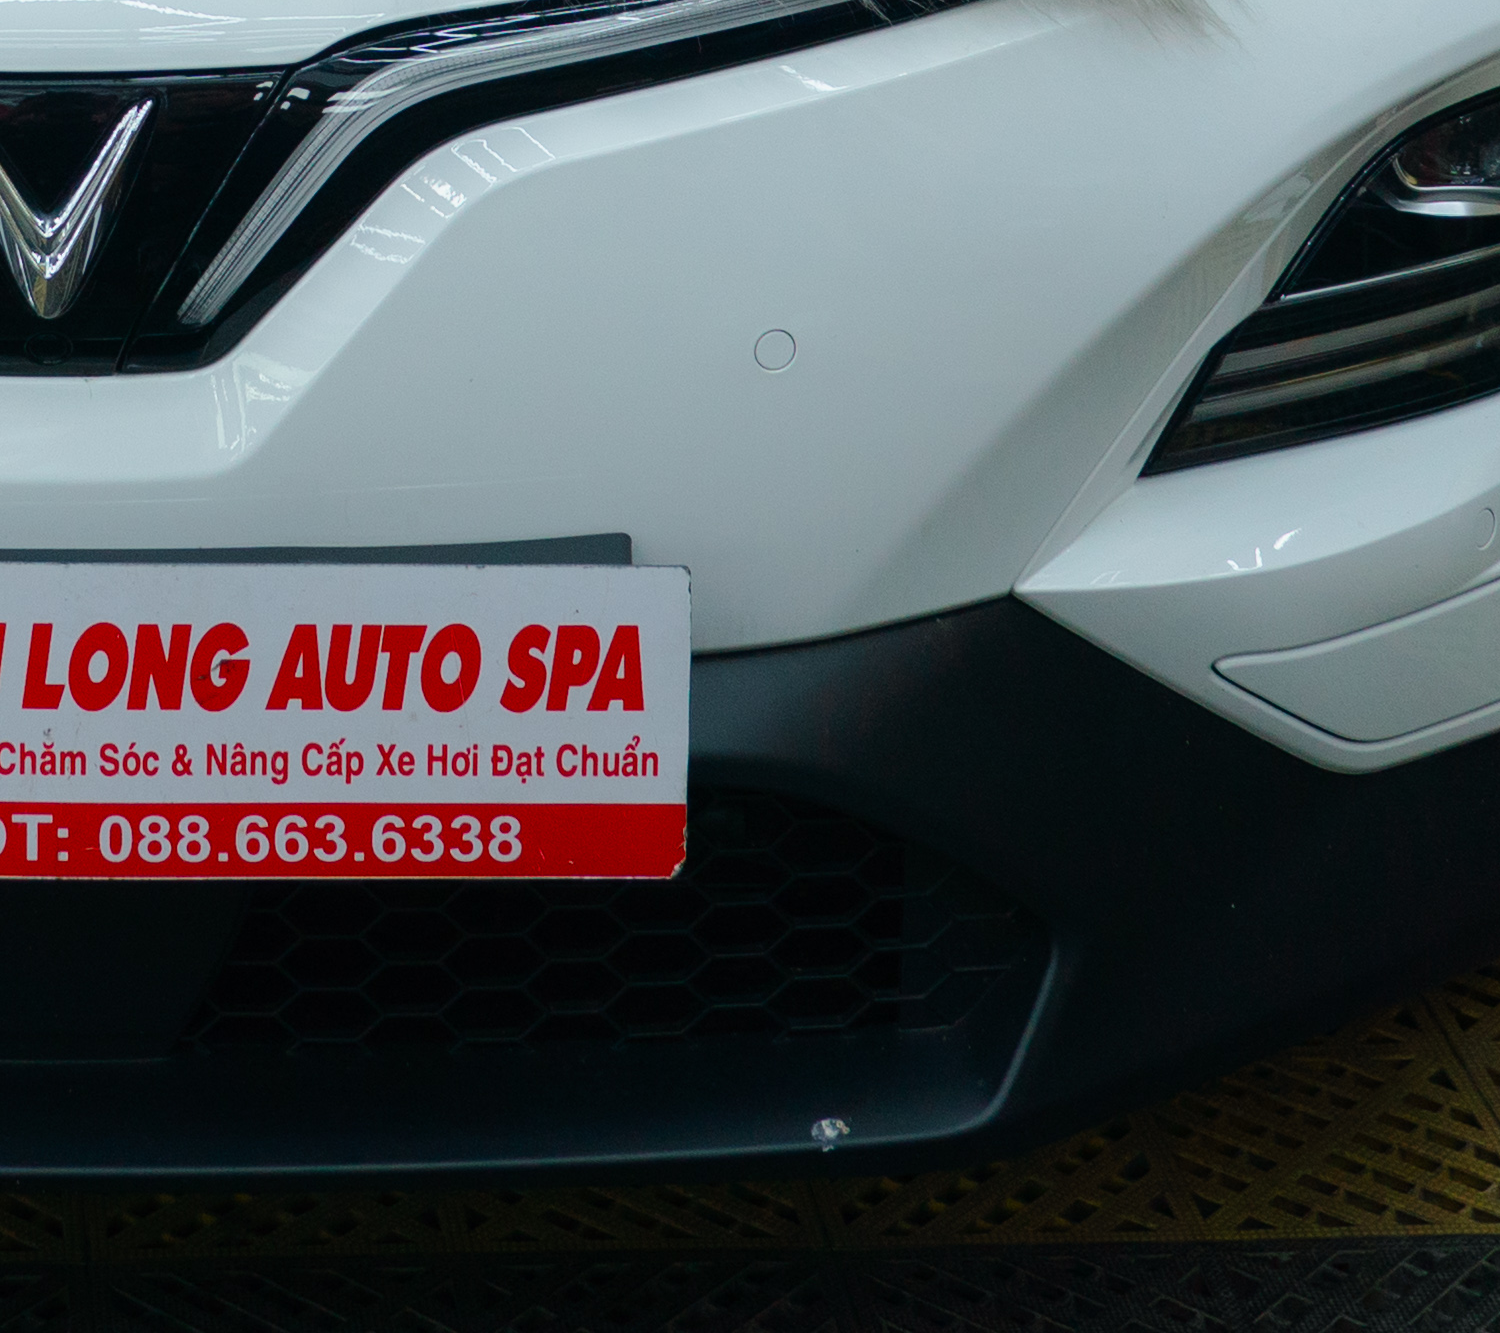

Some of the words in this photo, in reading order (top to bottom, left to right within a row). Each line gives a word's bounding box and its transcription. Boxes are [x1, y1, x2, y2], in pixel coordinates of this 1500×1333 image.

[22, 621, 251, 712] LONG
[265, 623, 482, 713] AUTO
[500, 624, 645, 713] SPA
[99, 741, 160, 777] Sóc
[171, 743, 193, 777] &
[206, 743, 289, 785] Nâng
[301, 737, 364, 784] Cấp
[376, 744, 415, 777] Xe
[427, 743, 479, 777] Hơi
[491, 743, 544, 784] Đạt
[556, 735, 659, 777] Chuẩn
[98, 814, 522, 863] 088.663.6338
